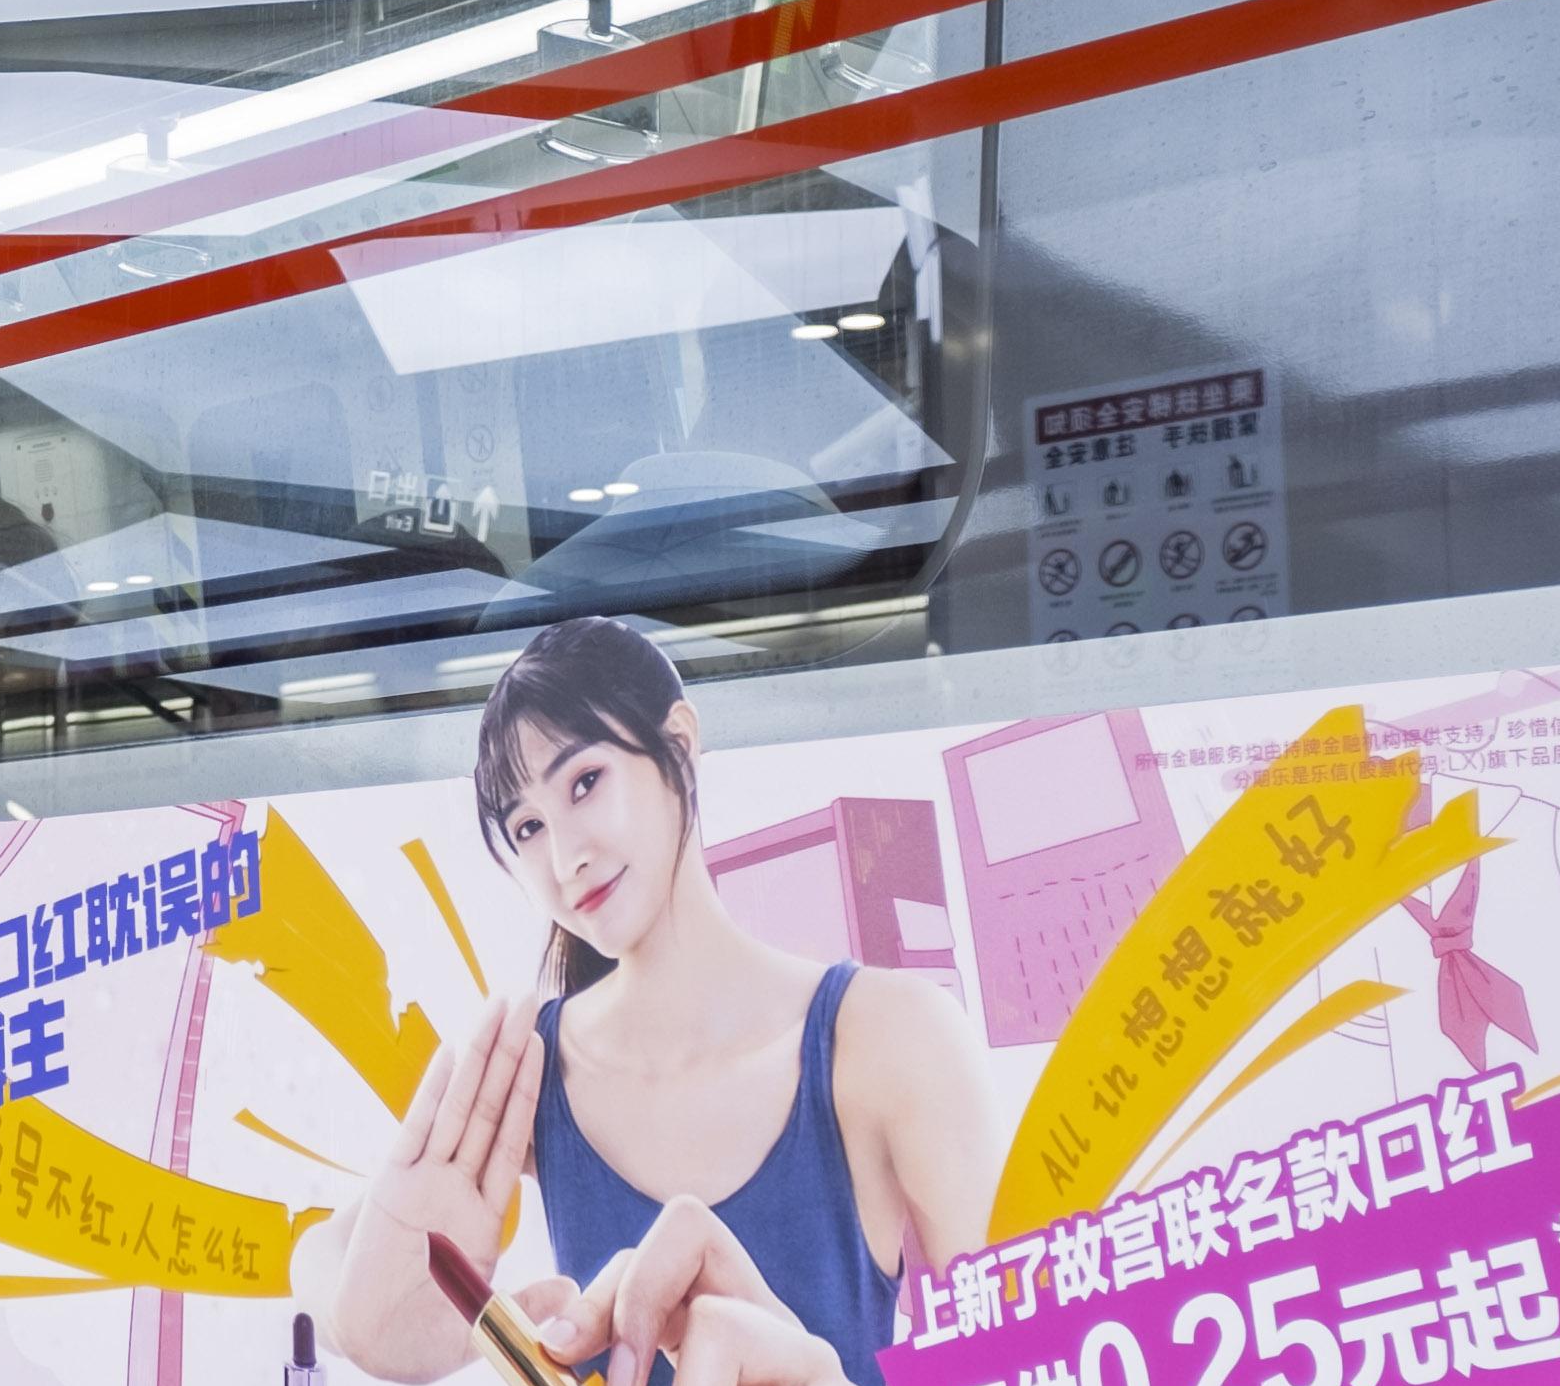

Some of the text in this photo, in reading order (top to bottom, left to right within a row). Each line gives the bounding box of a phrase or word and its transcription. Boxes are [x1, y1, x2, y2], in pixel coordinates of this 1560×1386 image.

[912, 1069, 1534, 1351] 上新了故宫联名款口红
[1039, 1113, 1091, 1198] All
[1088, 1063, 1138, 1117] in
